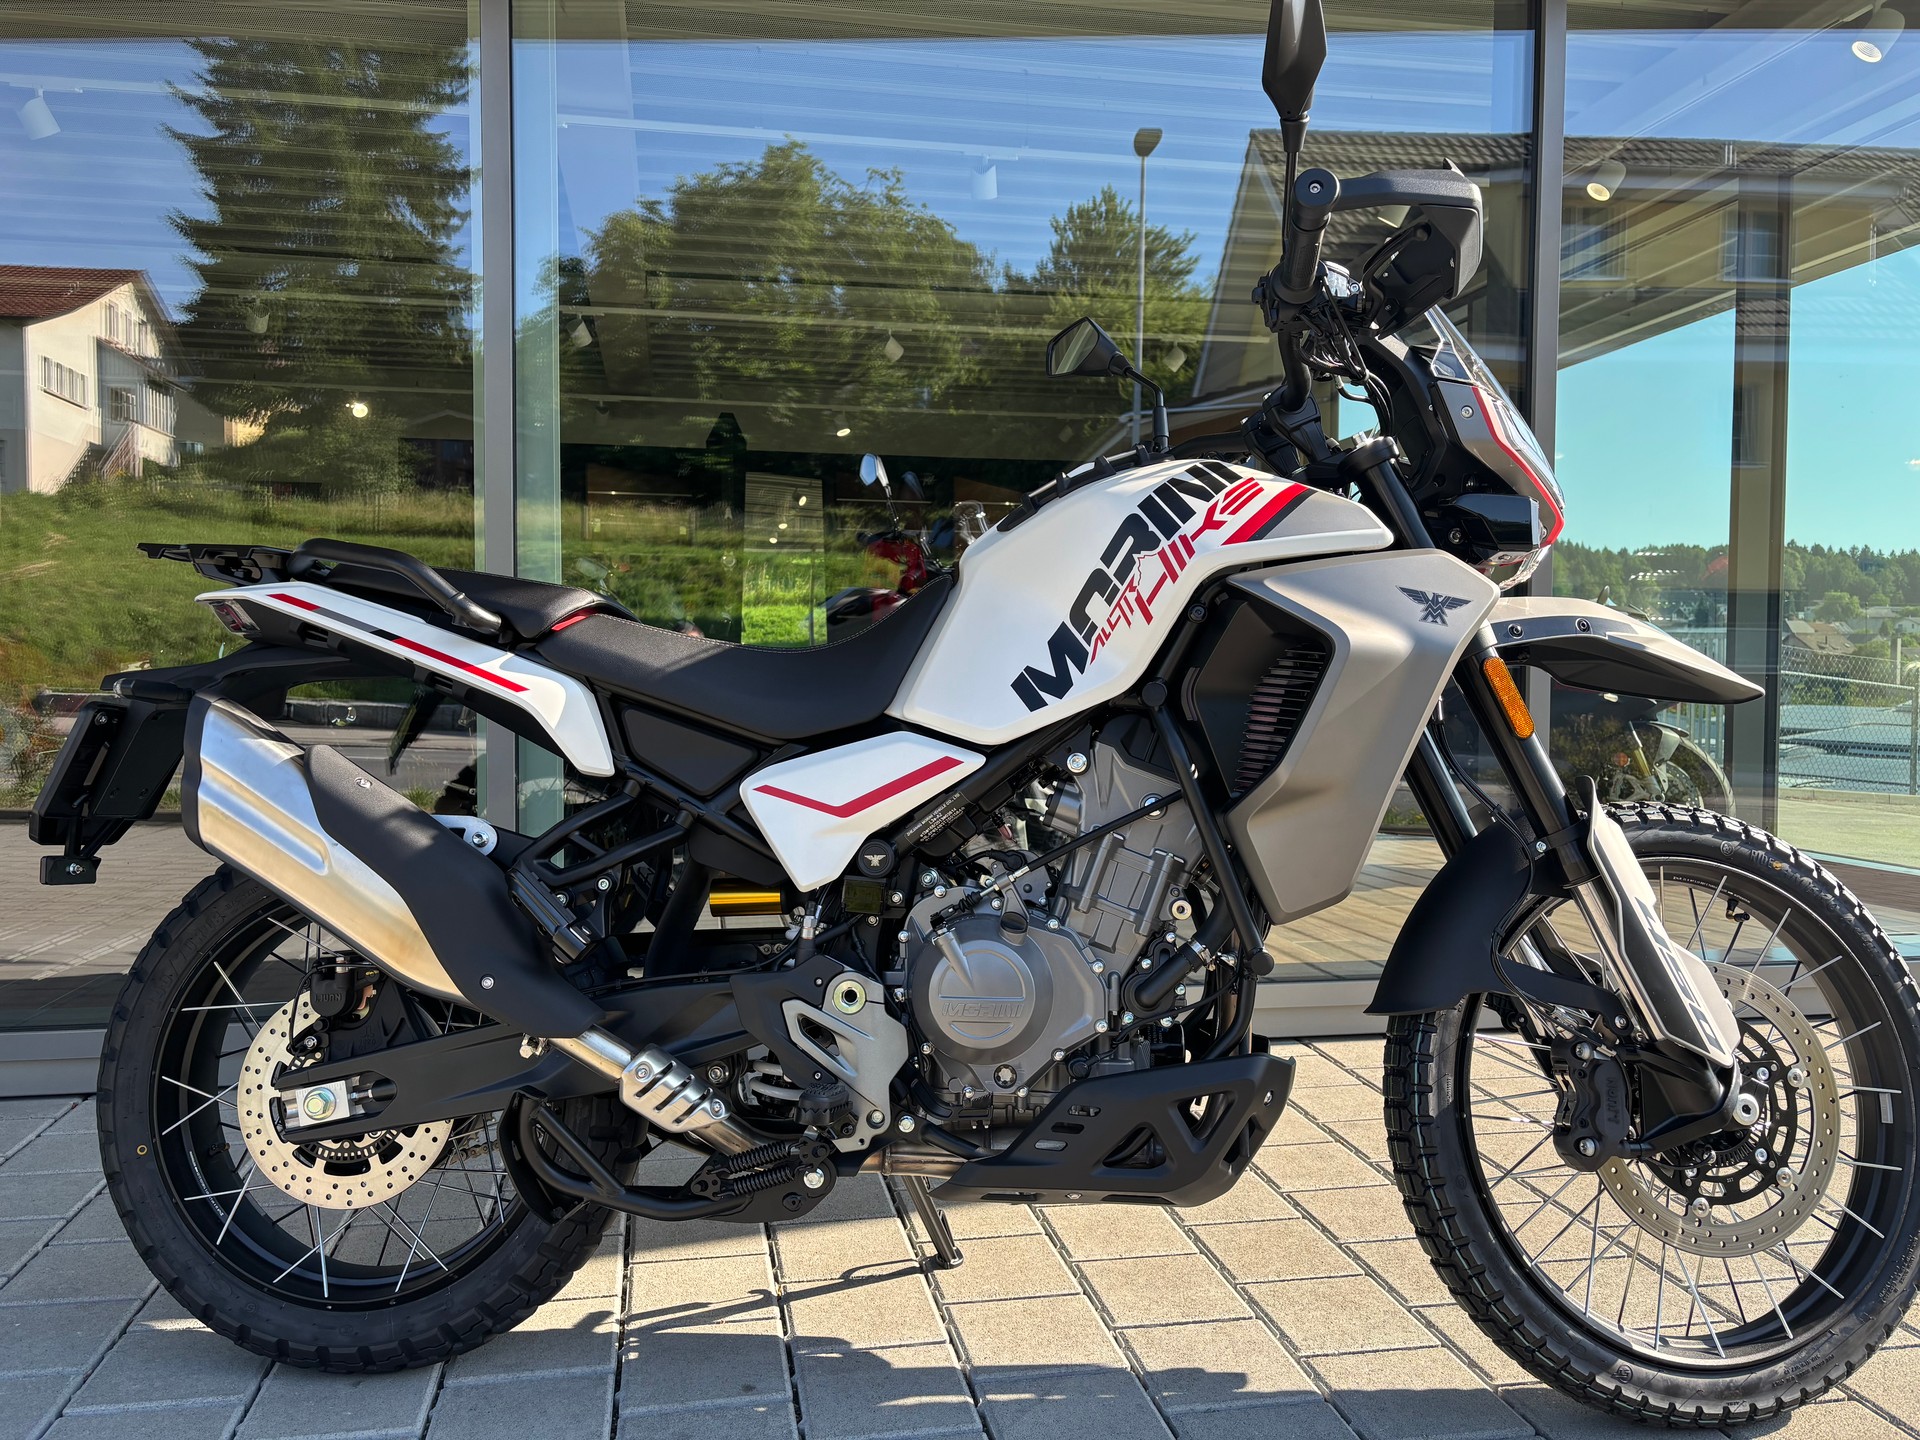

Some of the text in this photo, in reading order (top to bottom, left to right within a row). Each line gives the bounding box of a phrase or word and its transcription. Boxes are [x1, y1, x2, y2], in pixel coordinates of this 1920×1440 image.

[1010, 461, 1243, 712] MORINI
[941, 1002, 1025, 1018] MORINI
[1634, 896, 1725, 1055] 450
